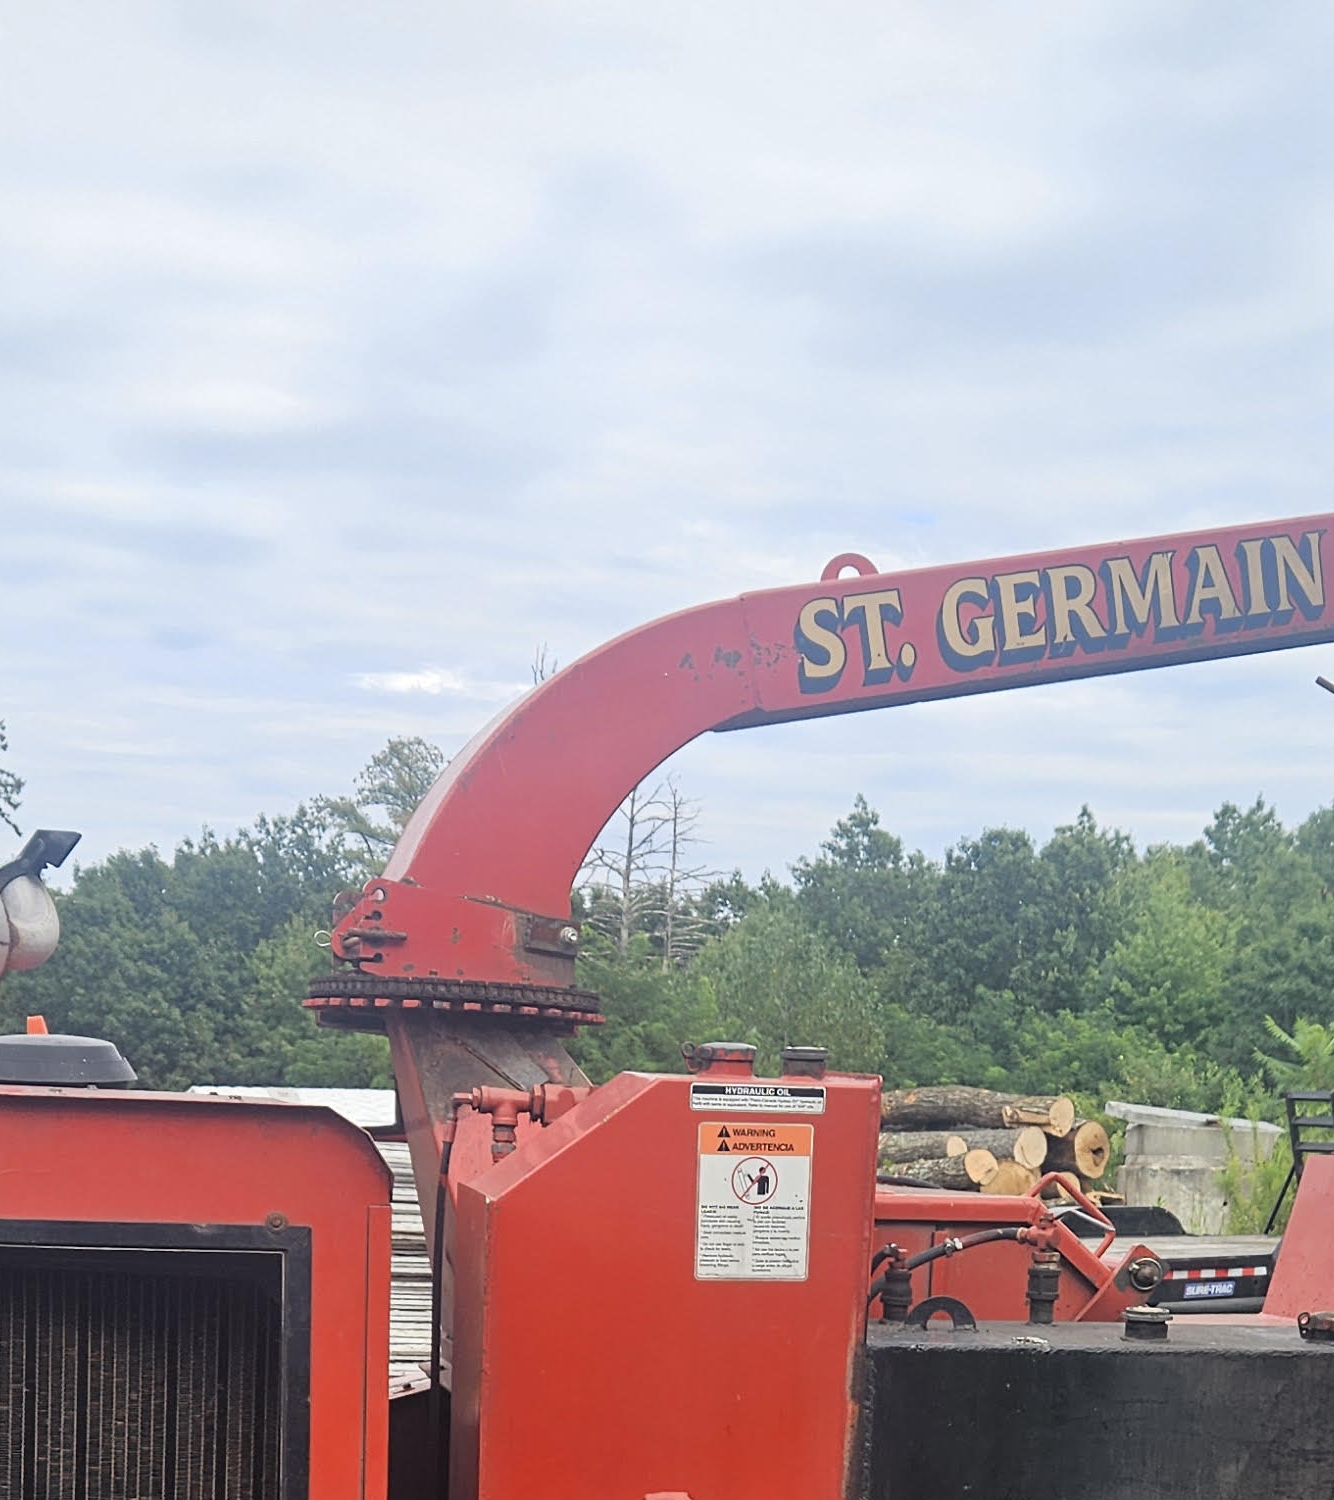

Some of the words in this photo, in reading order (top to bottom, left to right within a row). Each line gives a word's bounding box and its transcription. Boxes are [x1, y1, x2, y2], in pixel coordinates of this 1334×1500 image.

[794, 590, 917, 694] ST.
[937, 529, 1327, 672] GERMAIN
[724, 1086, 775, 1096] HYDRAULIC
[776, 1087, 791, 1097] OIL
[732, 1128, 776, 1138] WARNING
[732, 1142, 795, 1152] ADVERTENCIA
[1185, 1283, 1234, 1297] SURE-TRAC
